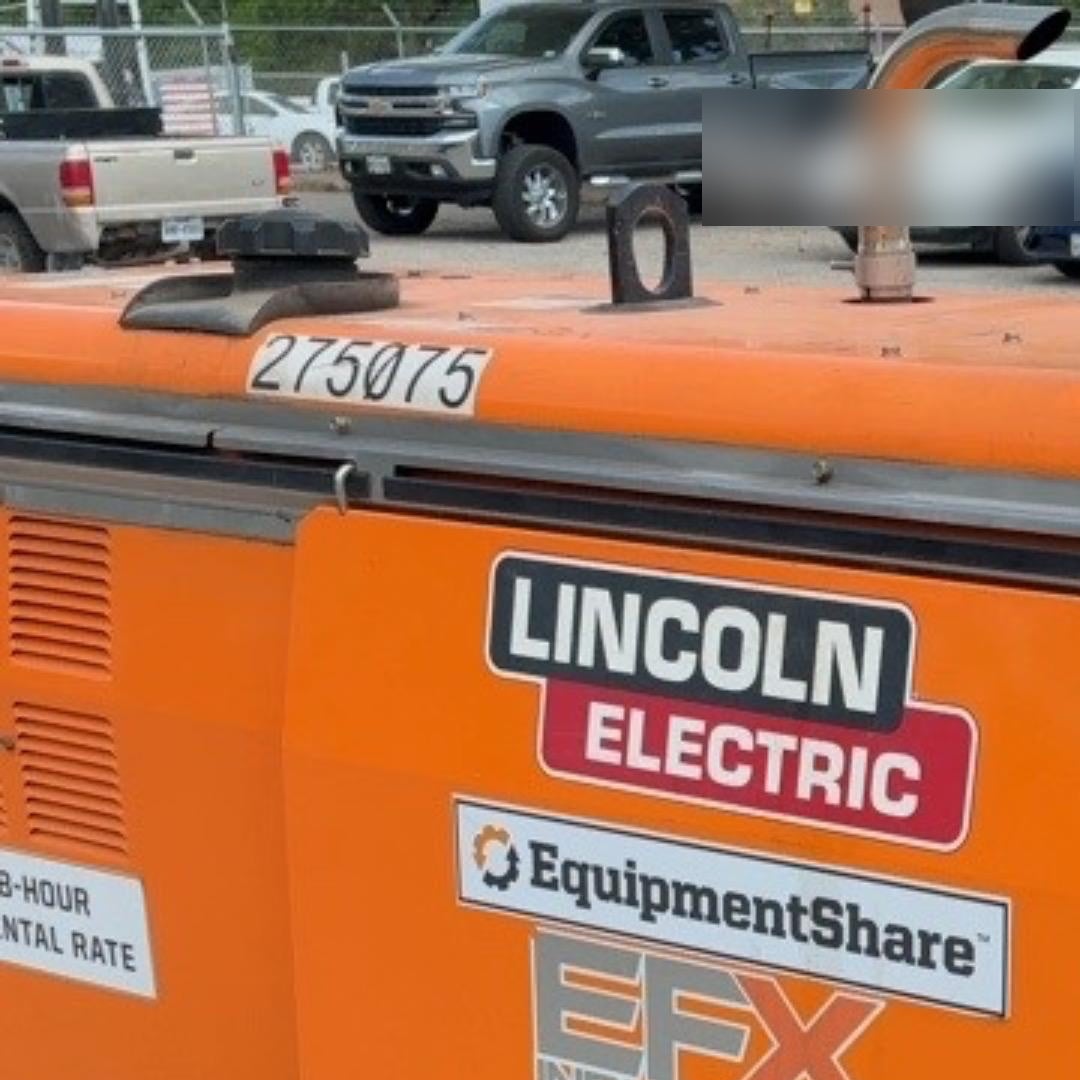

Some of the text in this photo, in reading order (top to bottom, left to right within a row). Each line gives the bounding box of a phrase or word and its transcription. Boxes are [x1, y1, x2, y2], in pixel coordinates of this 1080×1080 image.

[250, 335, 487, 408] 275075
[509, 576, 885, 714] LINCOLN
[584, 701, 922, 819] ELECTRIC
[0, 914, 137, 973] NTAL RATE
[529, 841, 976, 978] EquipmentShare
